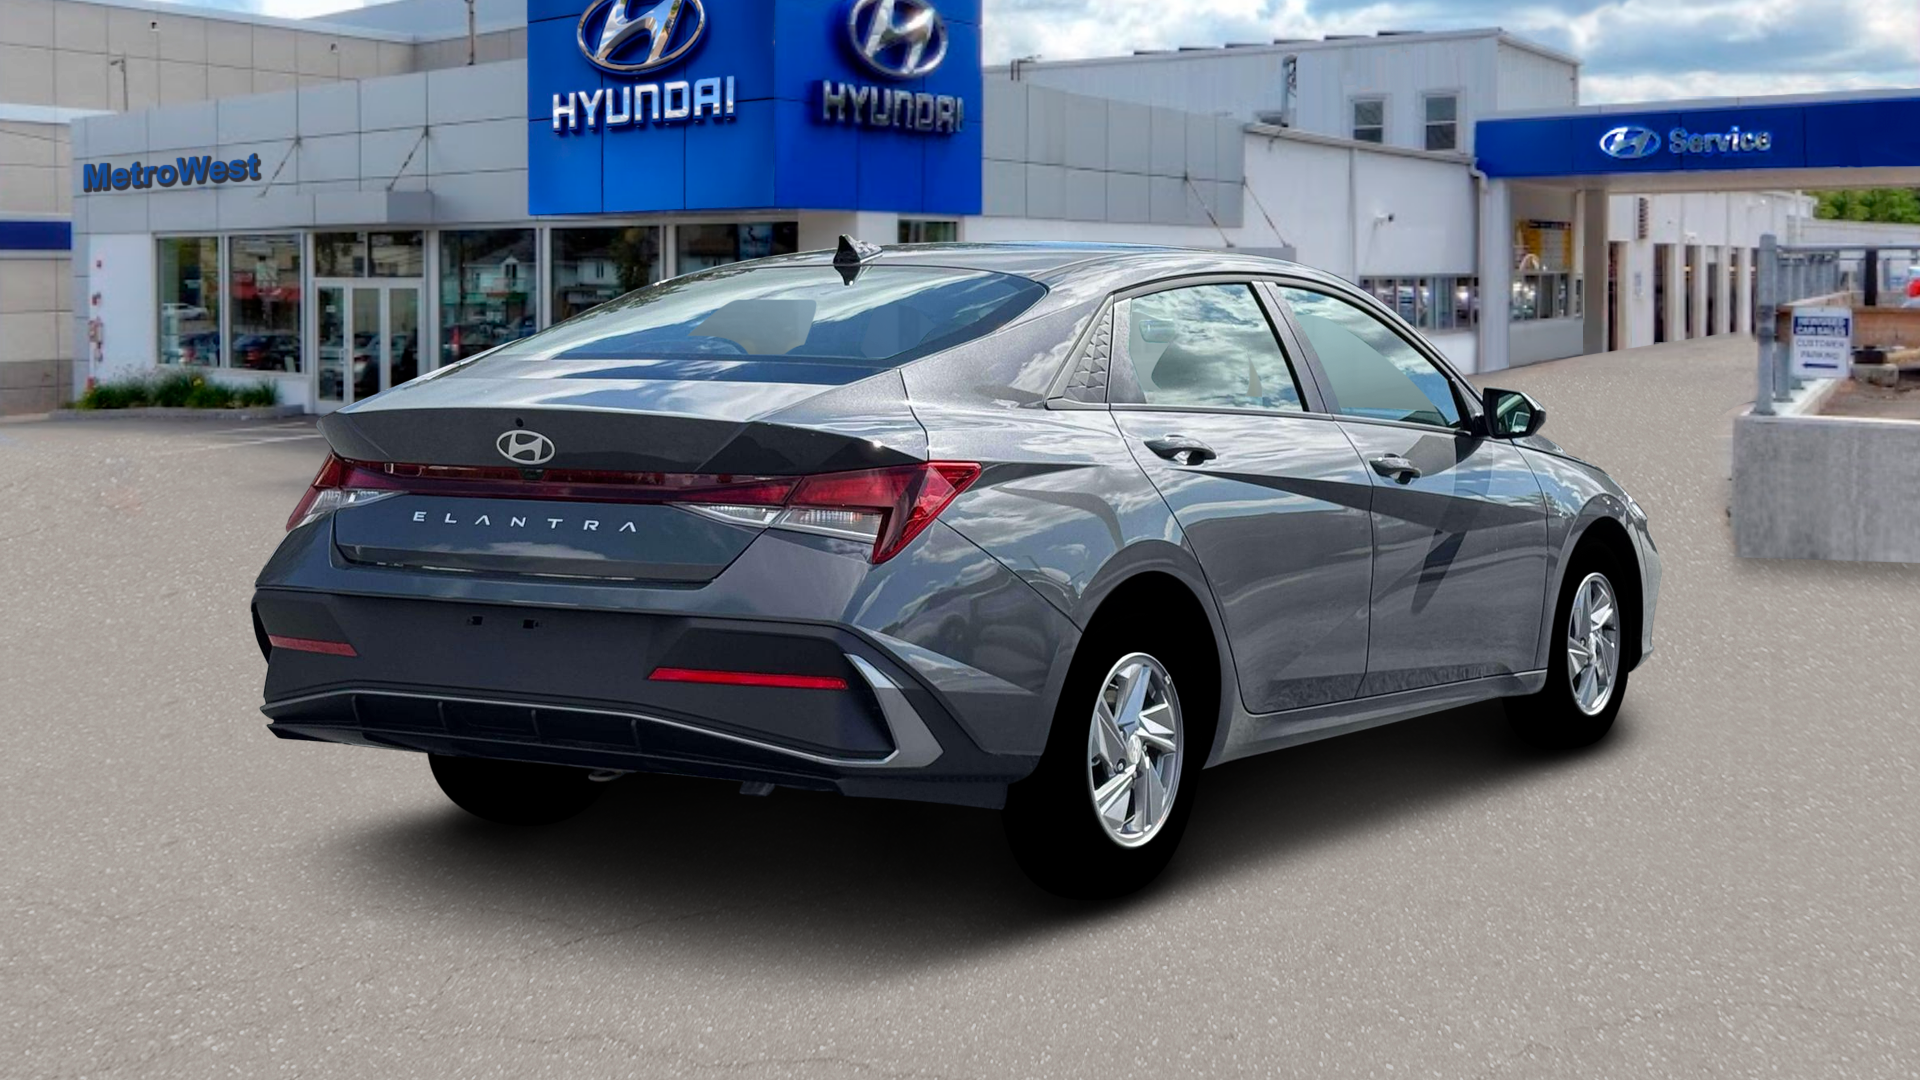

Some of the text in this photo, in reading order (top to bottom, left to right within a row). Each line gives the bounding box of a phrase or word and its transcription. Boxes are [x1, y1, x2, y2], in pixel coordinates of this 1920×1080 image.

[552, 75, 736, 133] HYUNDAI
[822, 79, 964, 133] HYUNDAI
[1668, 125, 1772, 154] Service
[83, 153, 262, 193] MetroWest
[412, 510, 638, 533] ELANTRA
